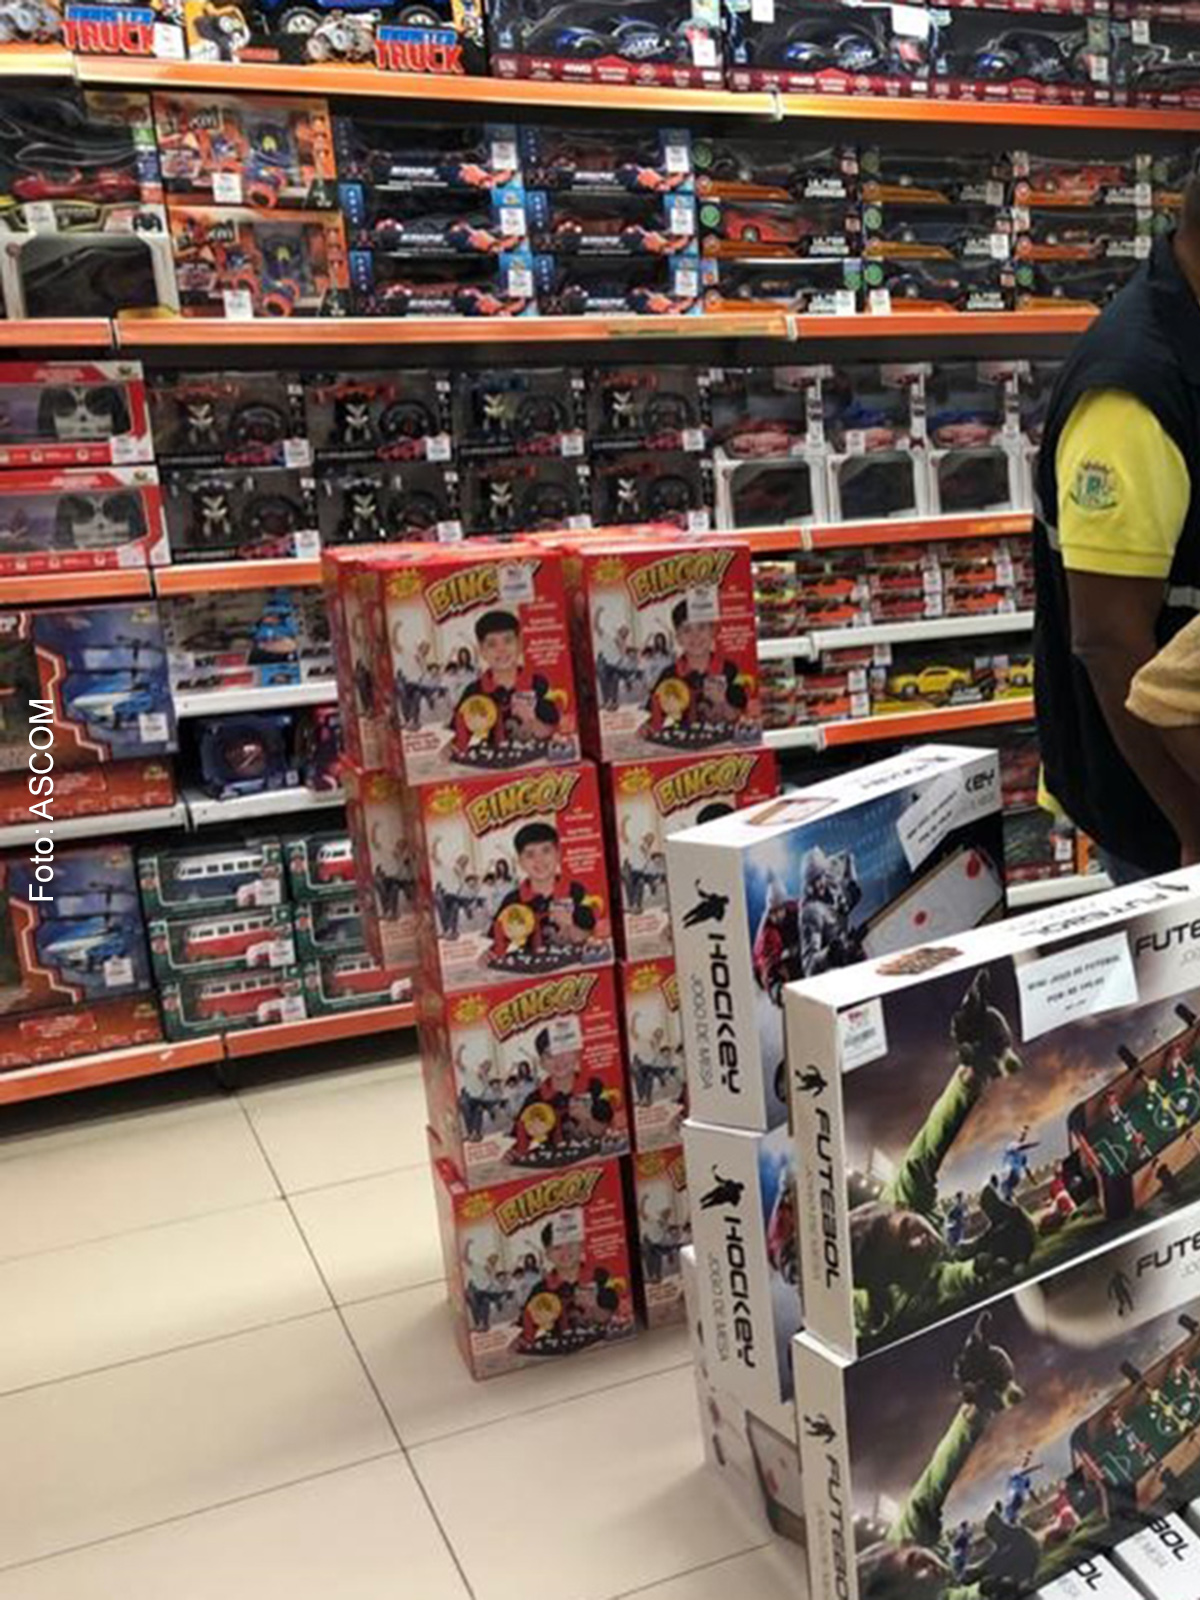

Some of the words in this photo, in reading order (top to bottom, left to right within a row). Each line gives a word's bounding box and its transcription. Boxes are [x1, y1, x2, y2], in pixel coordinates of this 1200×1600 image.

[374, 40, 465, 74] TRUCK
[630, 550, 734, 605] BINGO!
[470, 773, 579, 831] BINGO!
[658, 755, 756, 809] BINGO!
[495, 974, 598, 1037] BINGO!
[708, 933, 741, 1094] HOCKEY
[499, 1167, 602, 1229] BINGO!
[815, 1107, 841, 1289] FUTEBOL
[723, 1216, 756, 1369] HOCKEY
